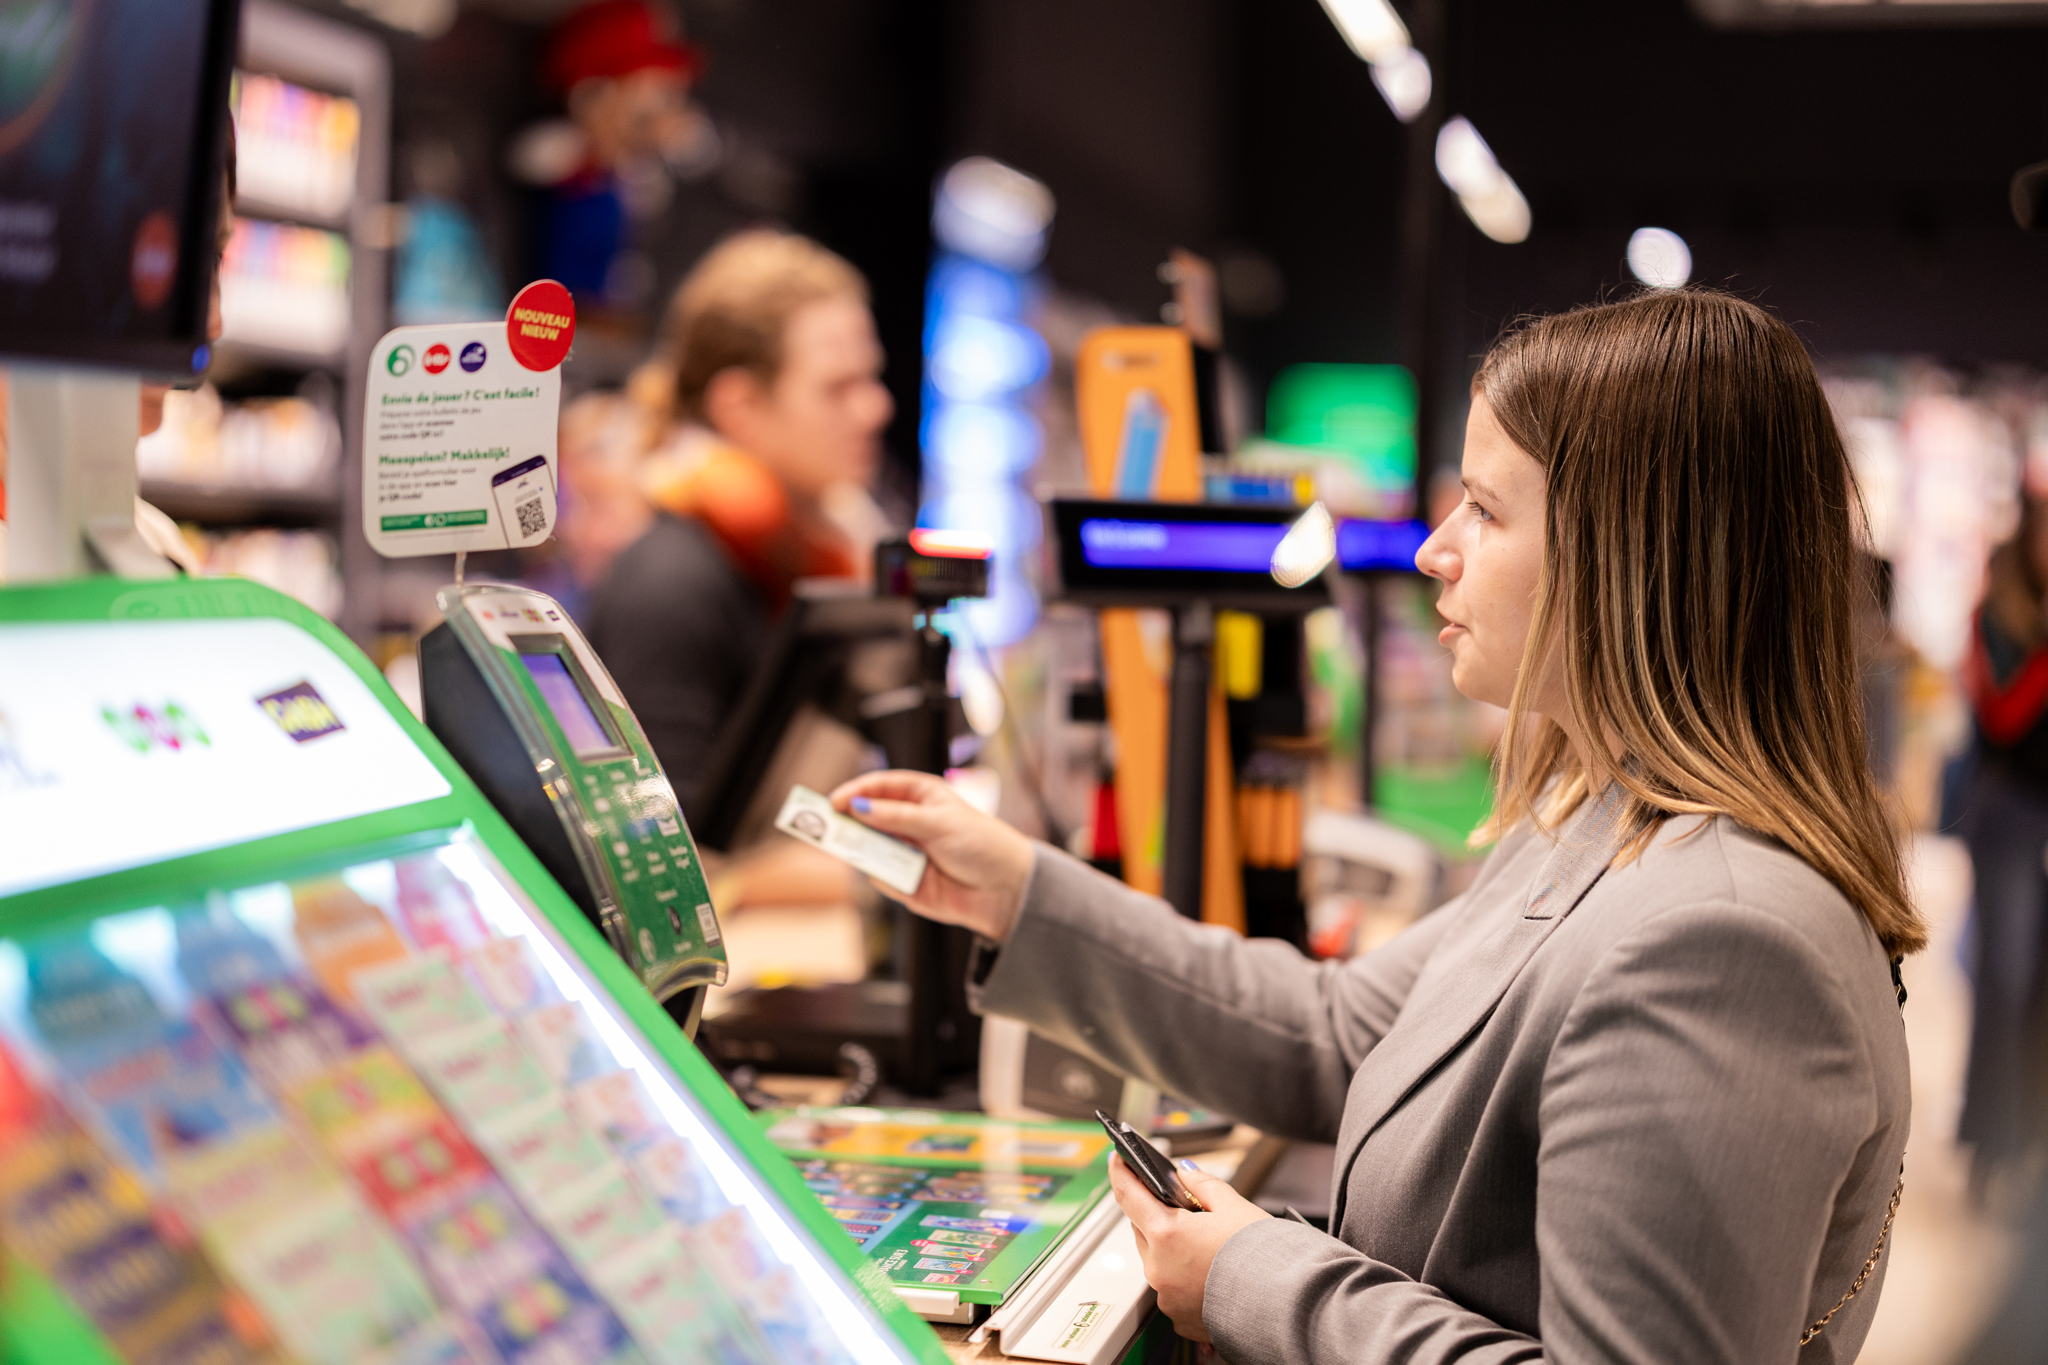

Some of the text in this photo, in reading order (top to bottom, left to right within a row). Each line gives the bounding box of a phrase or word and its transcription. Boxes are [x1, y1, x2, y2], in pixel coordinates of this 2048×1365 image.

[514, 307, 571, 328] NOUVEAU
[520, 323, 560, 341] NIEUW
[417, 391, 429, 403] de
